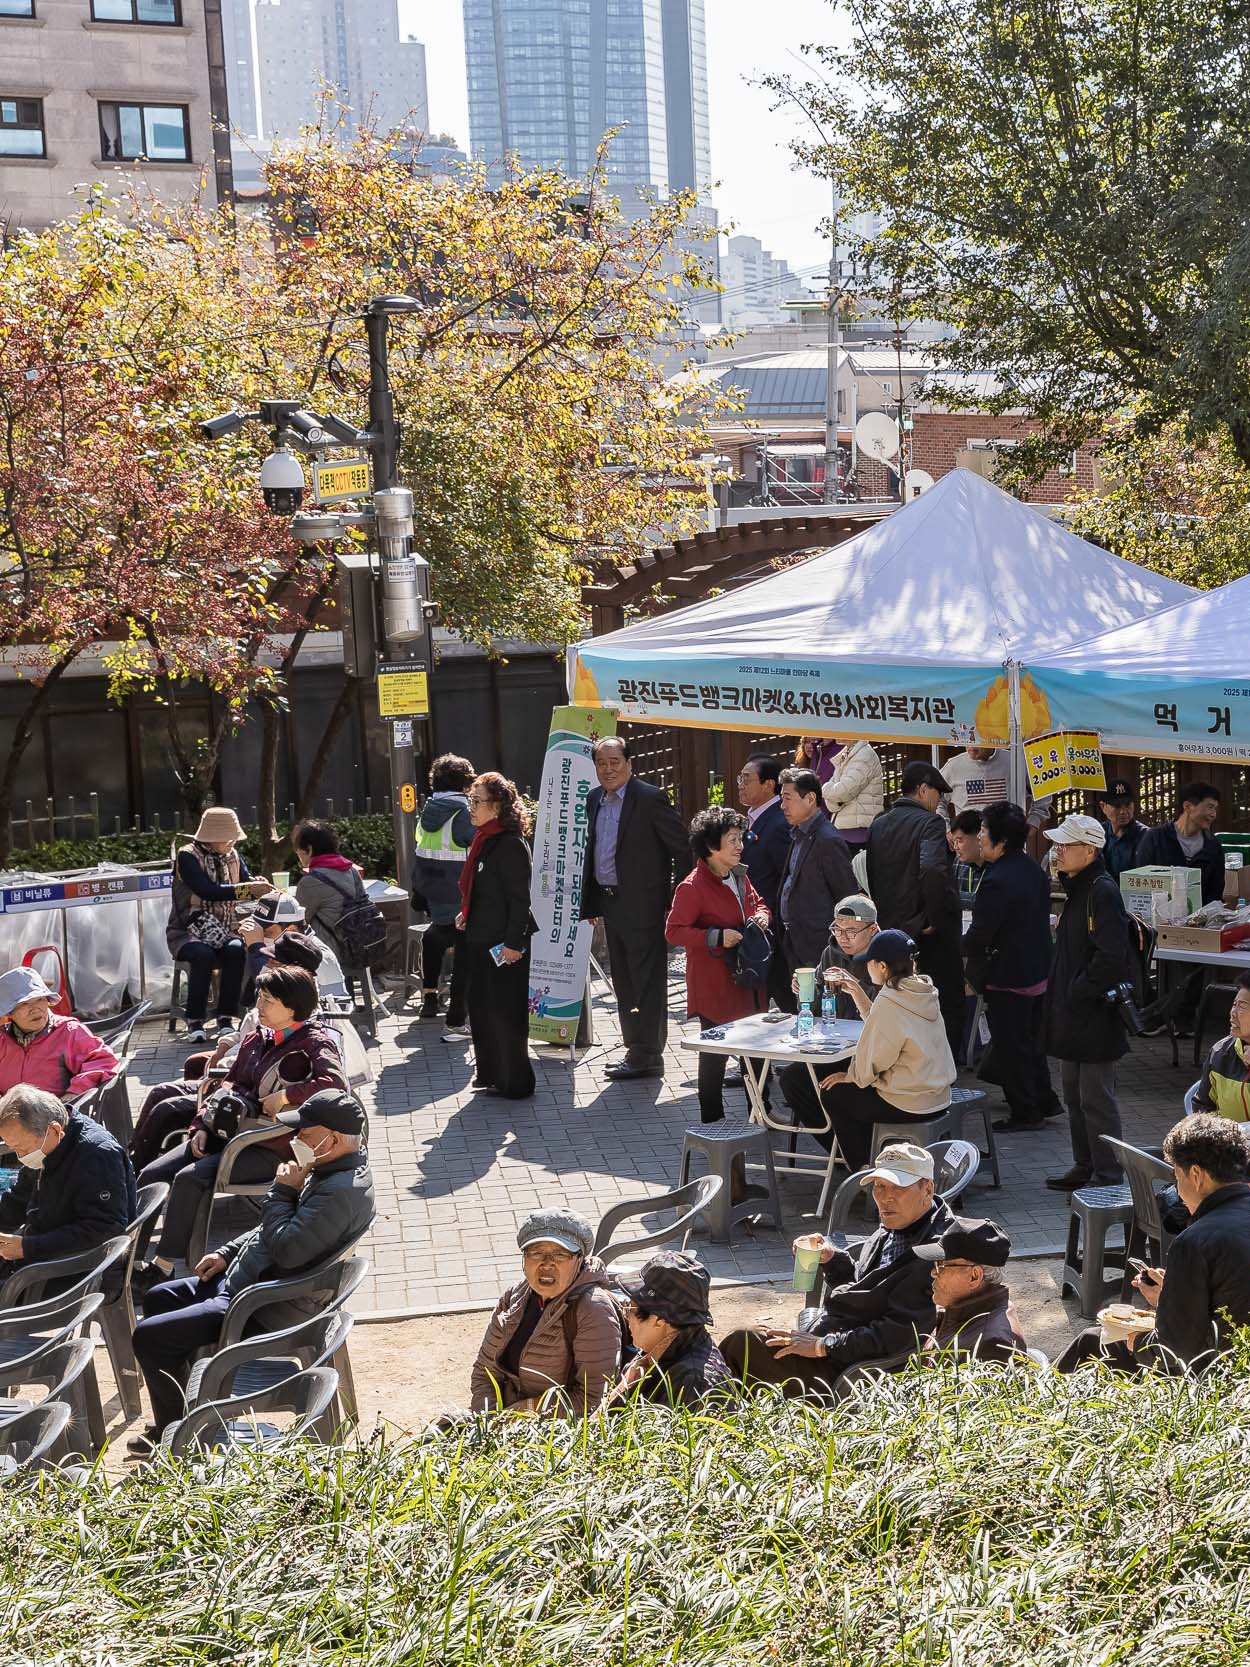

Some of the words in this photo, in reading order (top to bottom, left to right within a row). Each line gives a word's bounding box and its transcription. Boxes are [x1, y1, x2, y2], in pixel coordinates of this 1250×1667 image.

[320, 469, 366, 494] 다목적CCTV작동중
[618, 680, 956, 724] 광진푸드뱅크마켓&자양사회복지관
[1223, 688, 1240, 696] 2025
[1206, 746, 1233, 756] 3,000원
[572, 779, 590, 866] 후원자가
[550, 758, 572, 944] 광진푸드뱅크마켓센터의
[26, 888, 52, 900] 비닐류
[564, 874, 582, 958] 되어주세요
